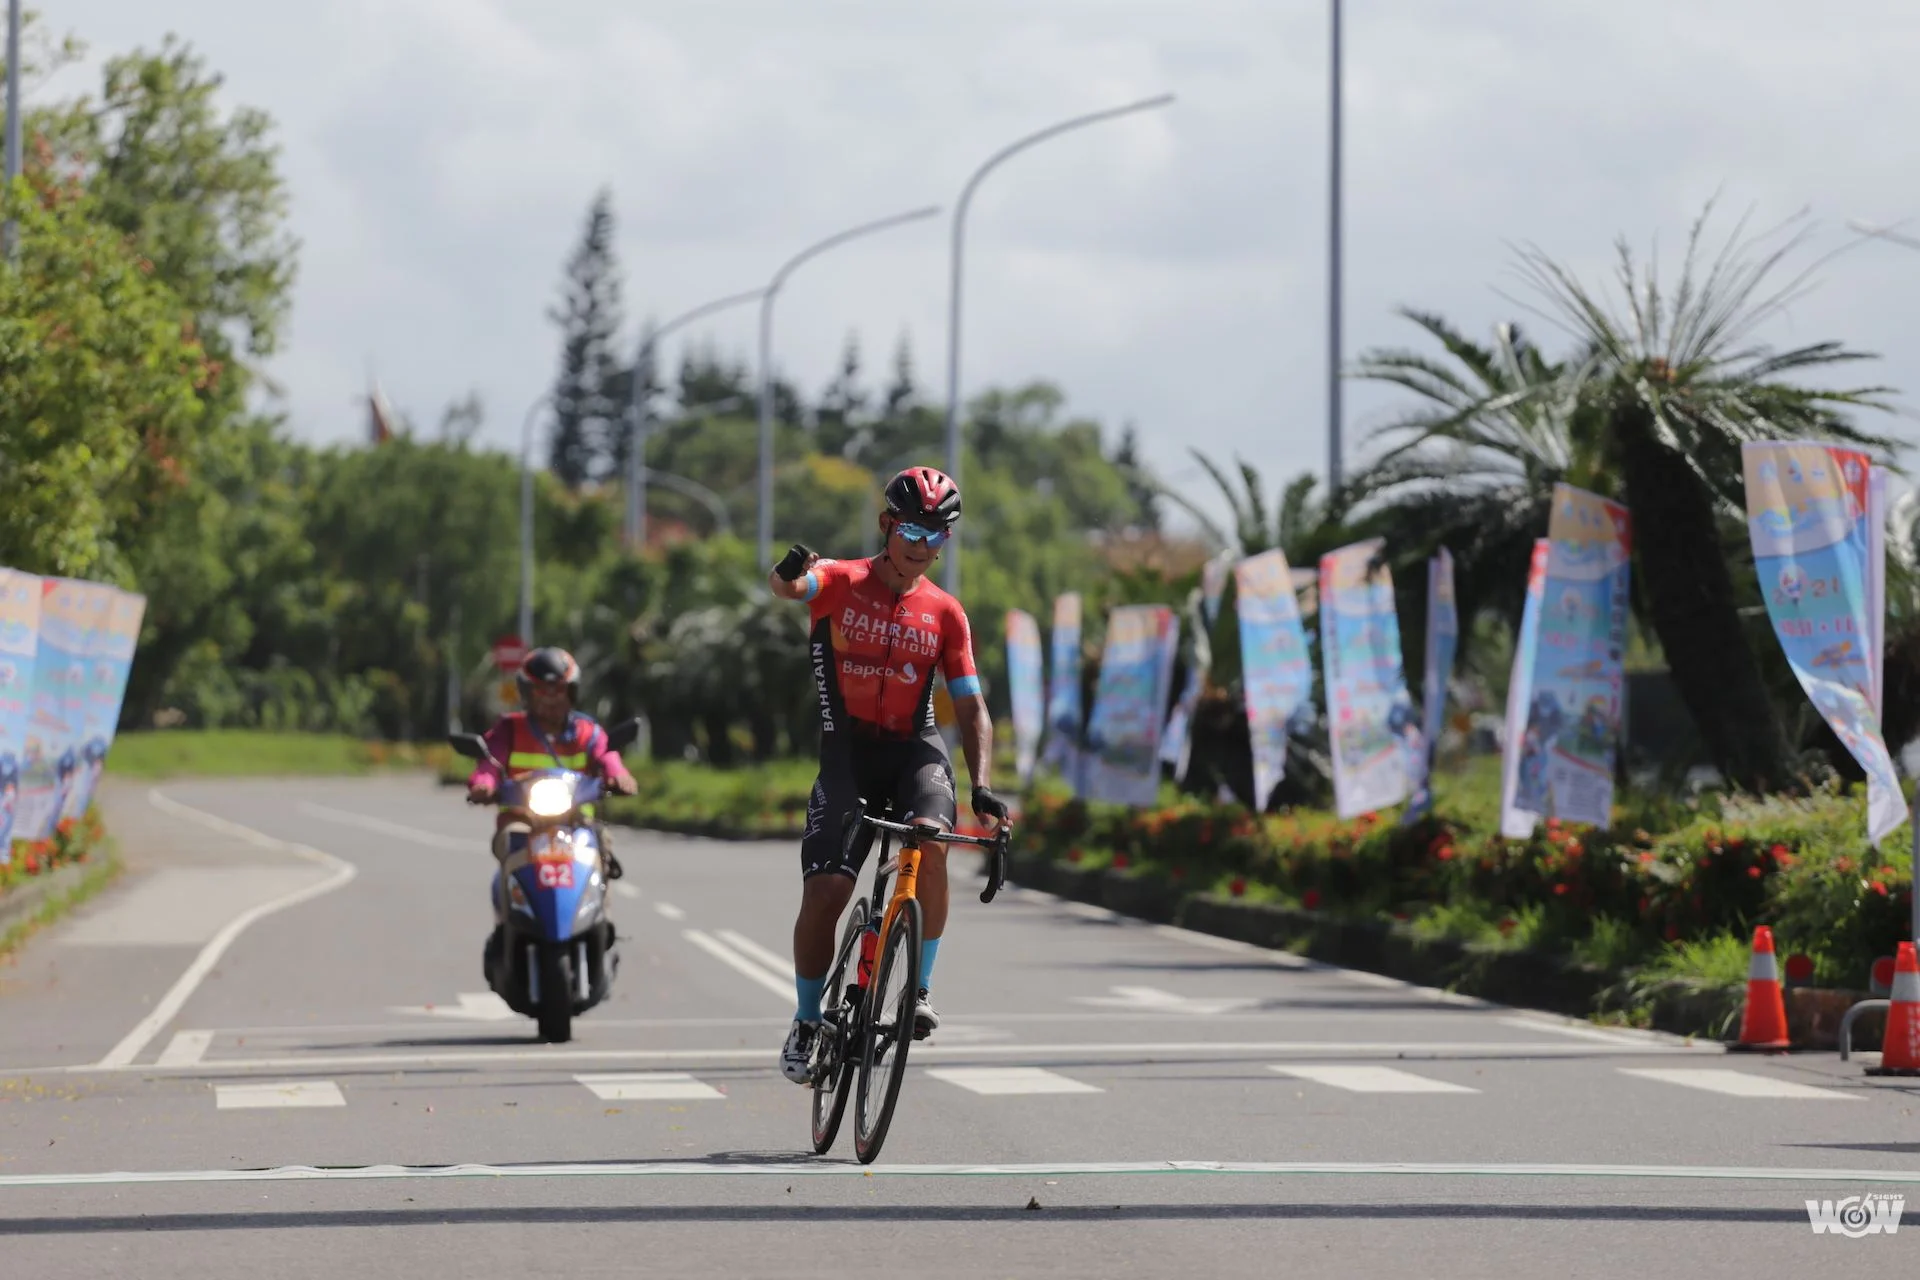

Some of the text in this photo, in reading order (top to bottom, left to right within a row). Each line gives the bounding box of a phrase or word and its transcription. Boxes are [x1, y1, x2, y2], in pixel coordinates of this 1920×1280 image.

[840, 626, 937, 657] VICTORIOUS
[842, 607, 938, 649] BAHRAIN
[842, 660, 895, 679] Bapco
[812, 643, 835, 732] BAHRAIN
[539, 863, 572, 888] C2
